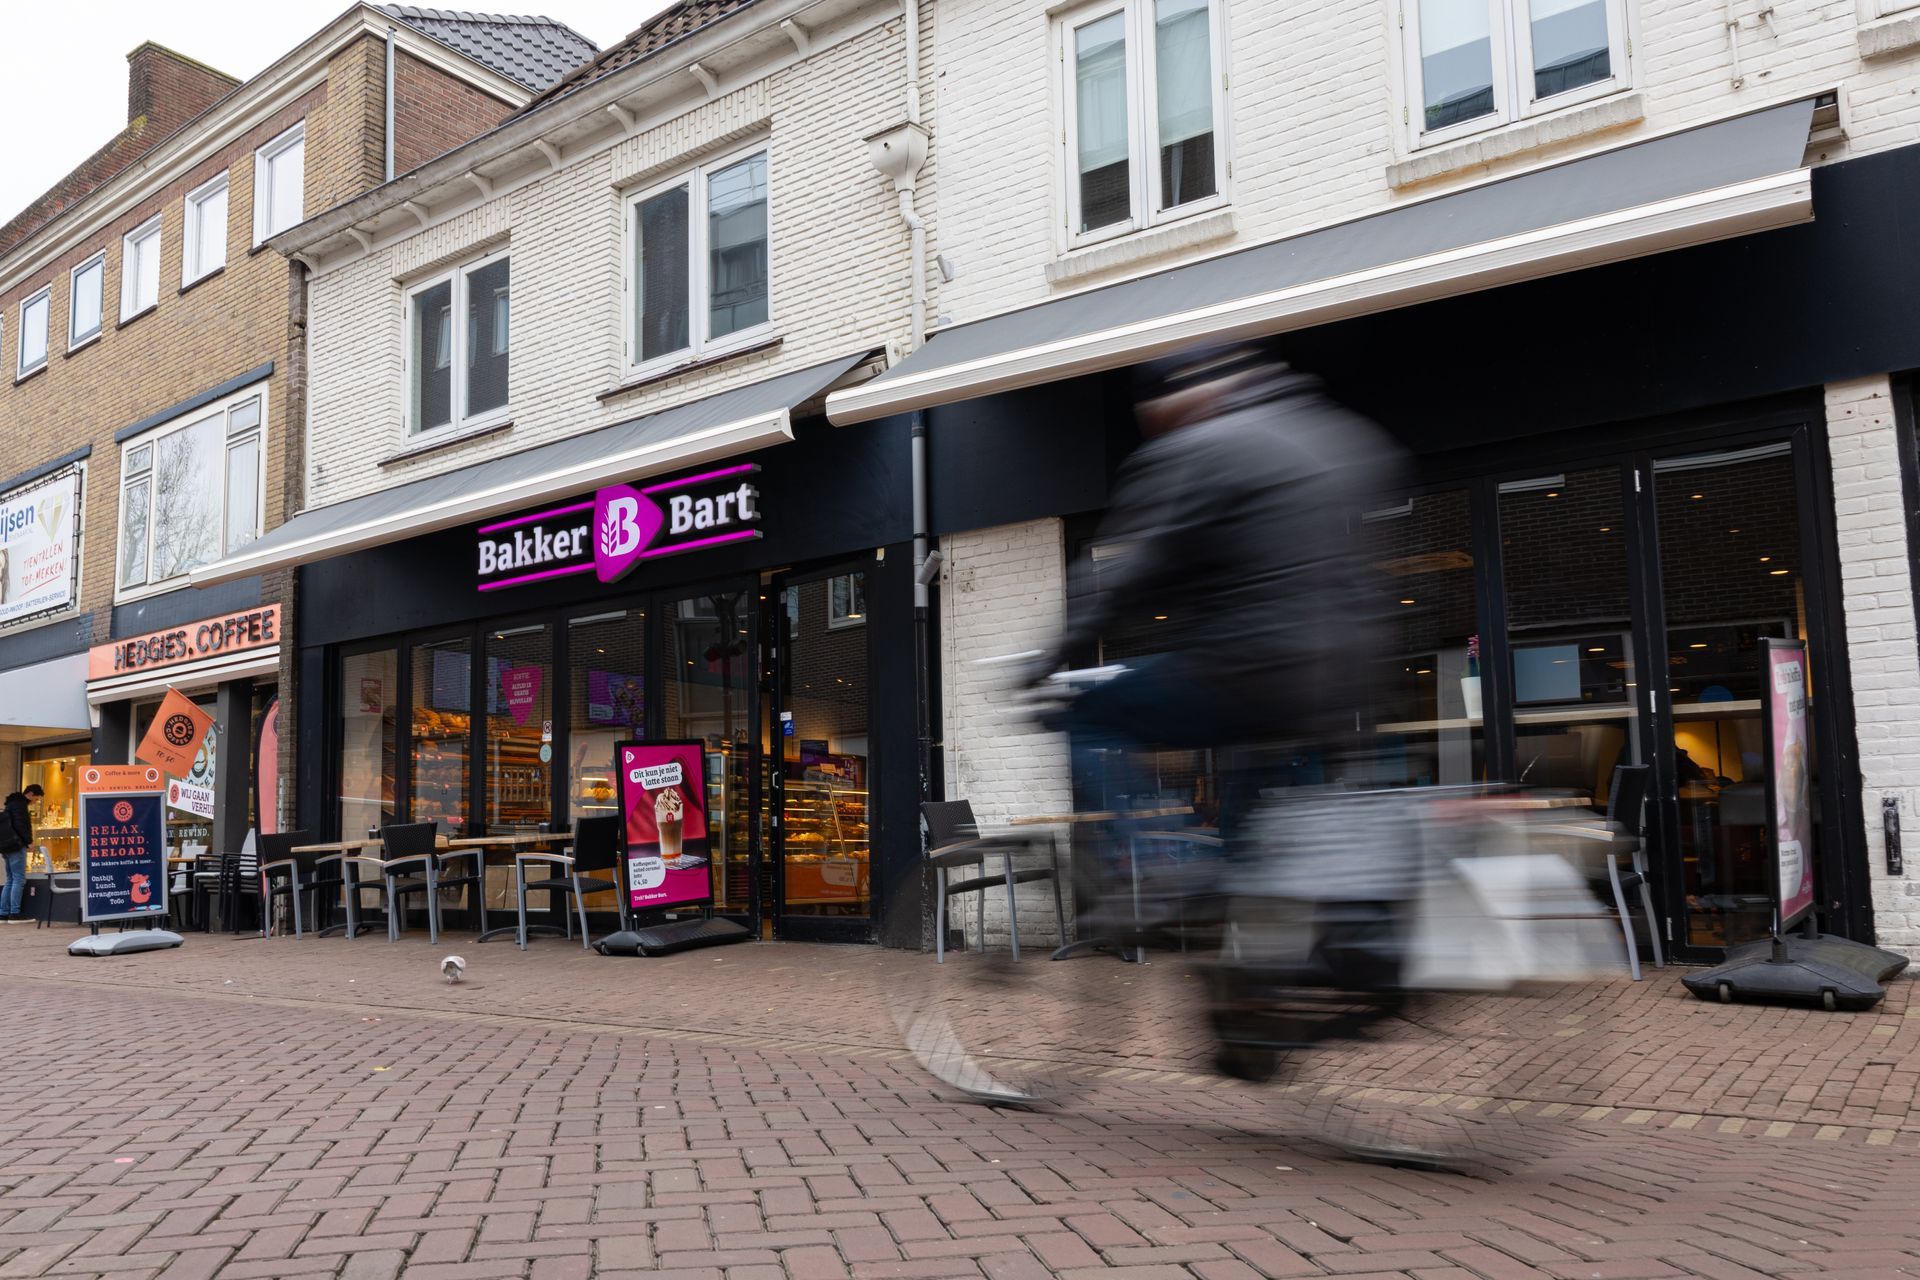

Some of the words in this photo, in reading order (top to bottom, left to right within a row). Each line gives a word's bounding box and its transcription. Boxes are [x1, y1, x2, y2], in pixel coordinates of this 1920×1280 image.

[478, 525, 588, 575] Bakker
[669, 483, 755, 535] Bart
[23, 542, 64, 569] TIENTALLEN
[634, 771, 644, 779] Dit
[645, 769, 658, 777] kun
[658, 767, 665, 776] je
[665, 765, 678, 773] niet
[645, 778, 660, 786] latte
[660, 774, 679, 784] staan
[181, 788, 192, 801] WIJ
[192, 790, 210, 802] GAAN
[90, 825, 145, 836] RELAX.
[178, 828, 210, 838] REWIND.
[90, 836, 149, 846] REWIND.
[90, 847, 149, 858] RELOAD.
[91, 874, 114, 882] Ontbijt
[88, 889, 130, 898] Arrangement
